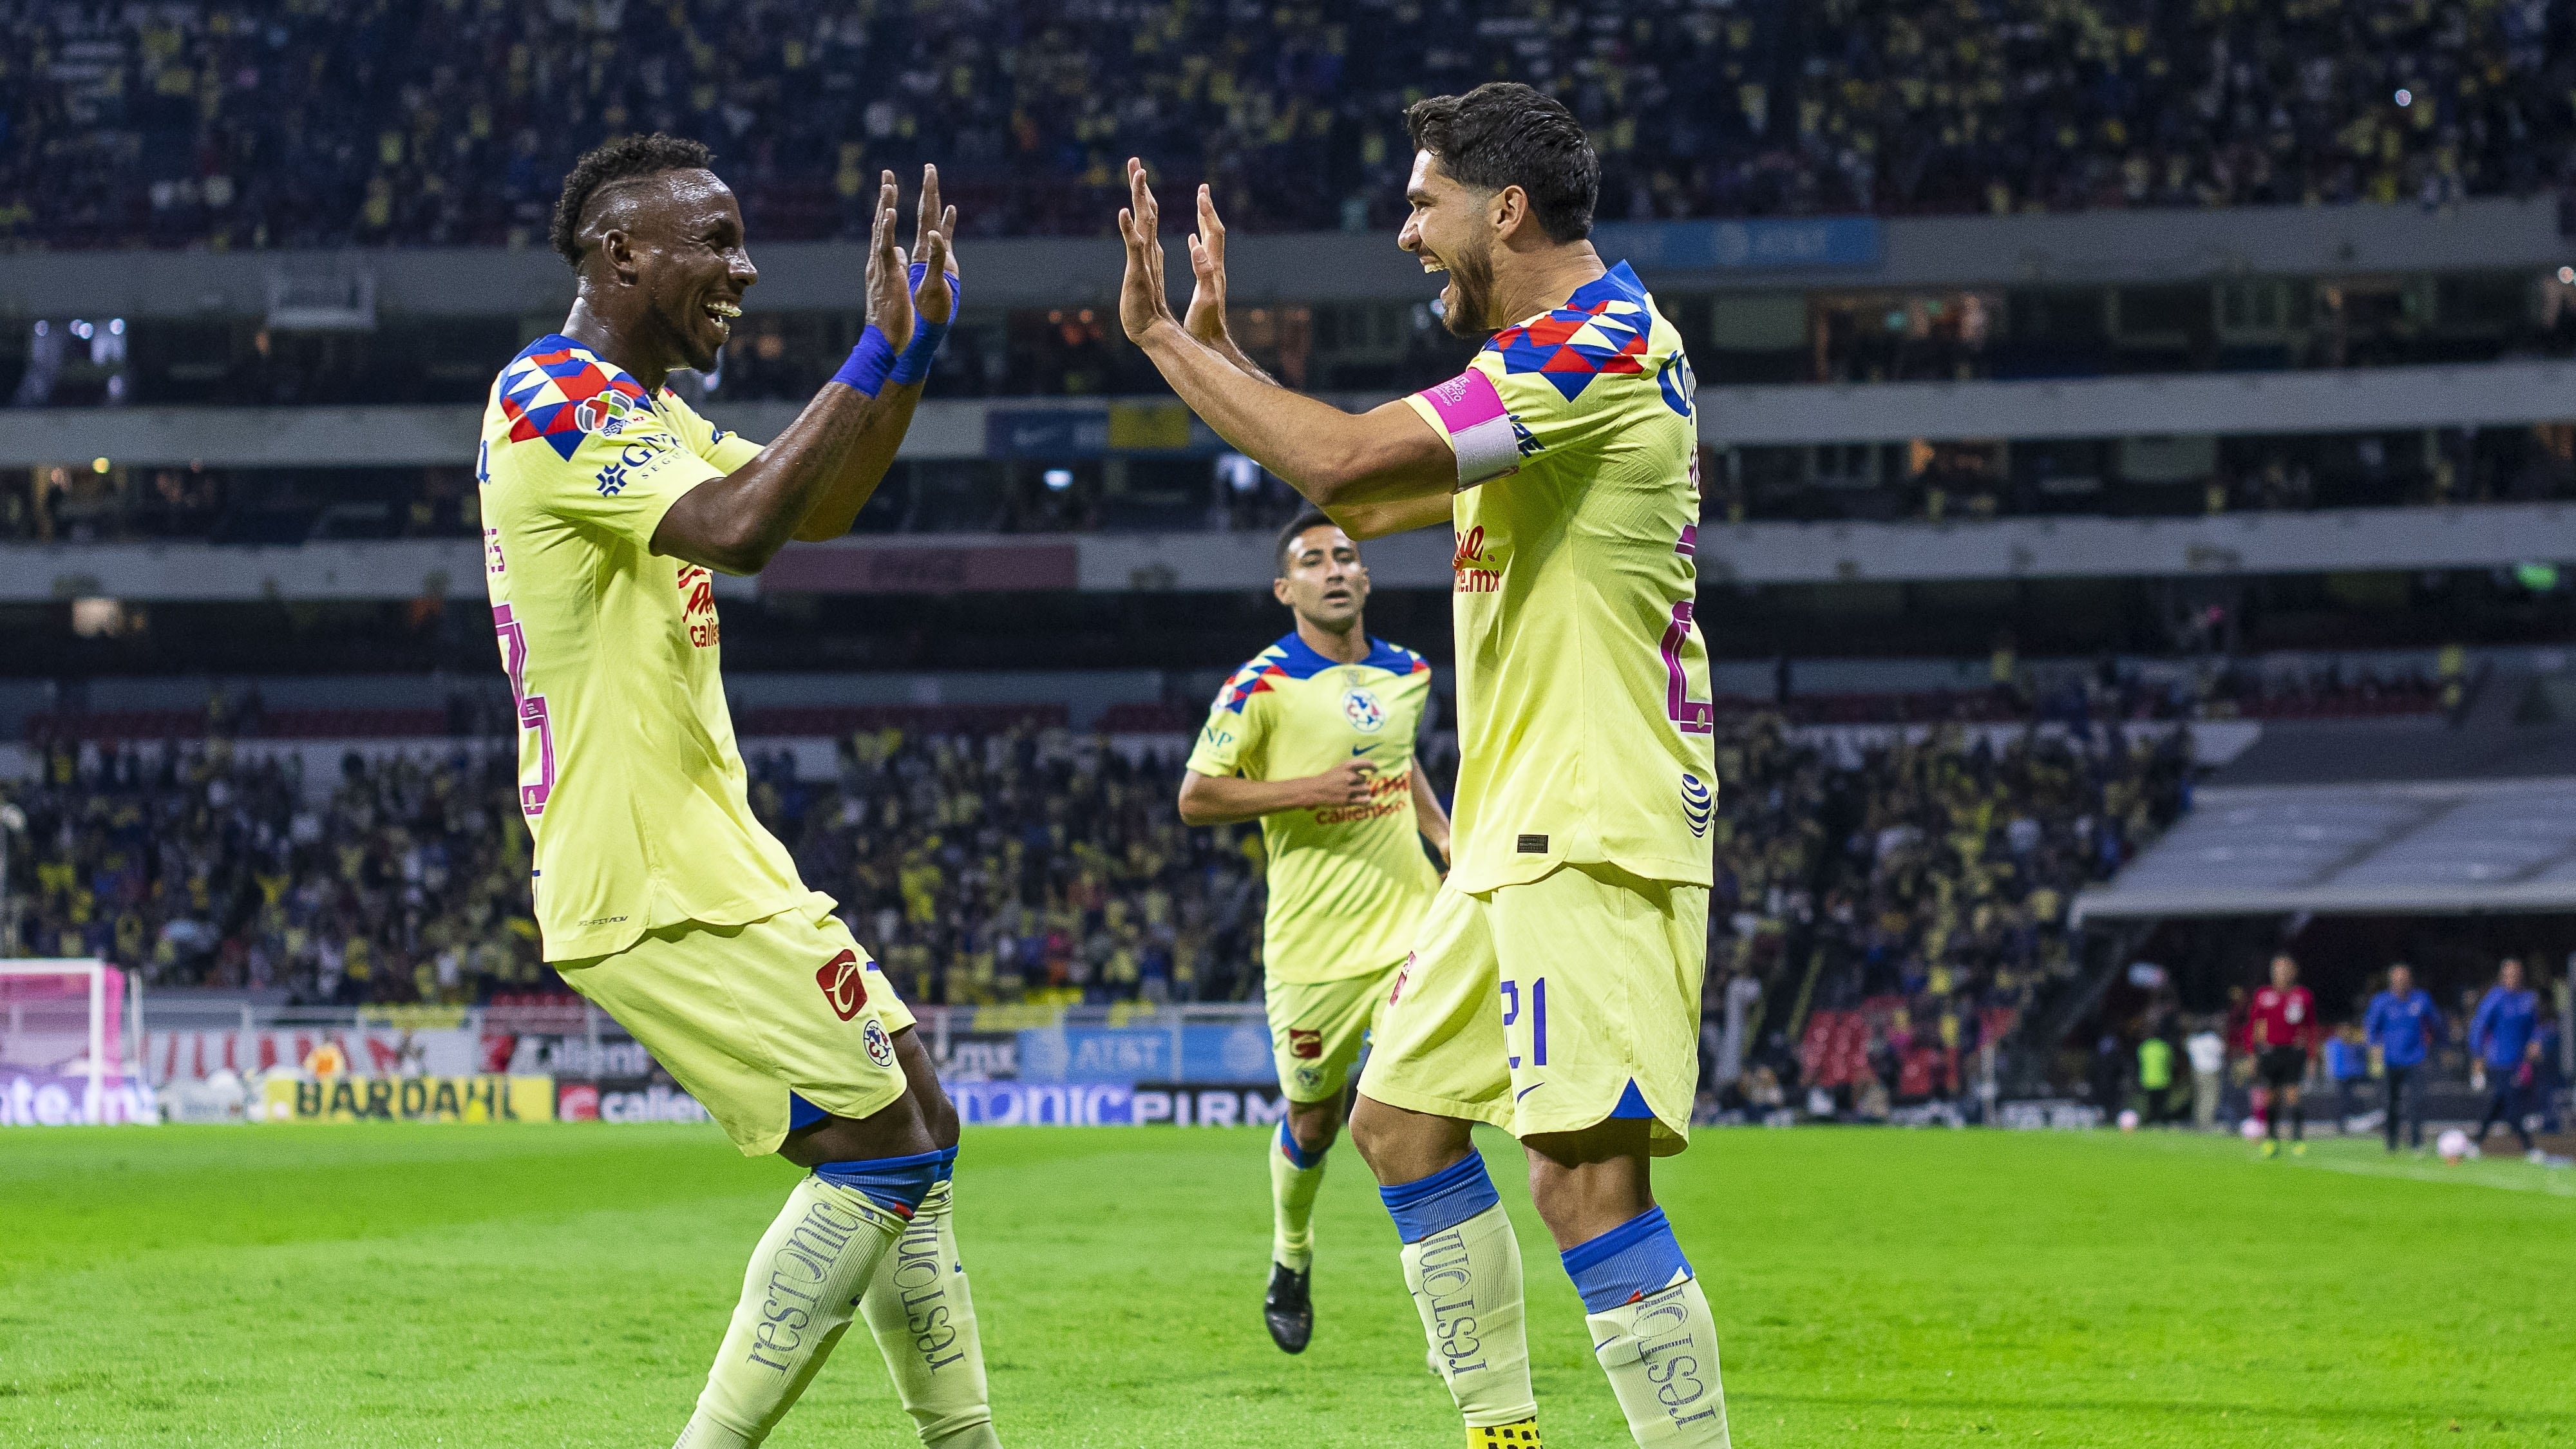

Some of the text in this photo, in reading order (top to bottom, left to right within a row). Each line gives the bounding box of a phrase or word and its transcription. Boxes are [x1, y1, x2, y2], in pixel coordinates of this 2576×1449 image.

[1501, 977, 1547, 1070] 21
[1076, 1036, 1163, 1070] AT&T
[295, 1077, 519, 1121] BARDAHL
